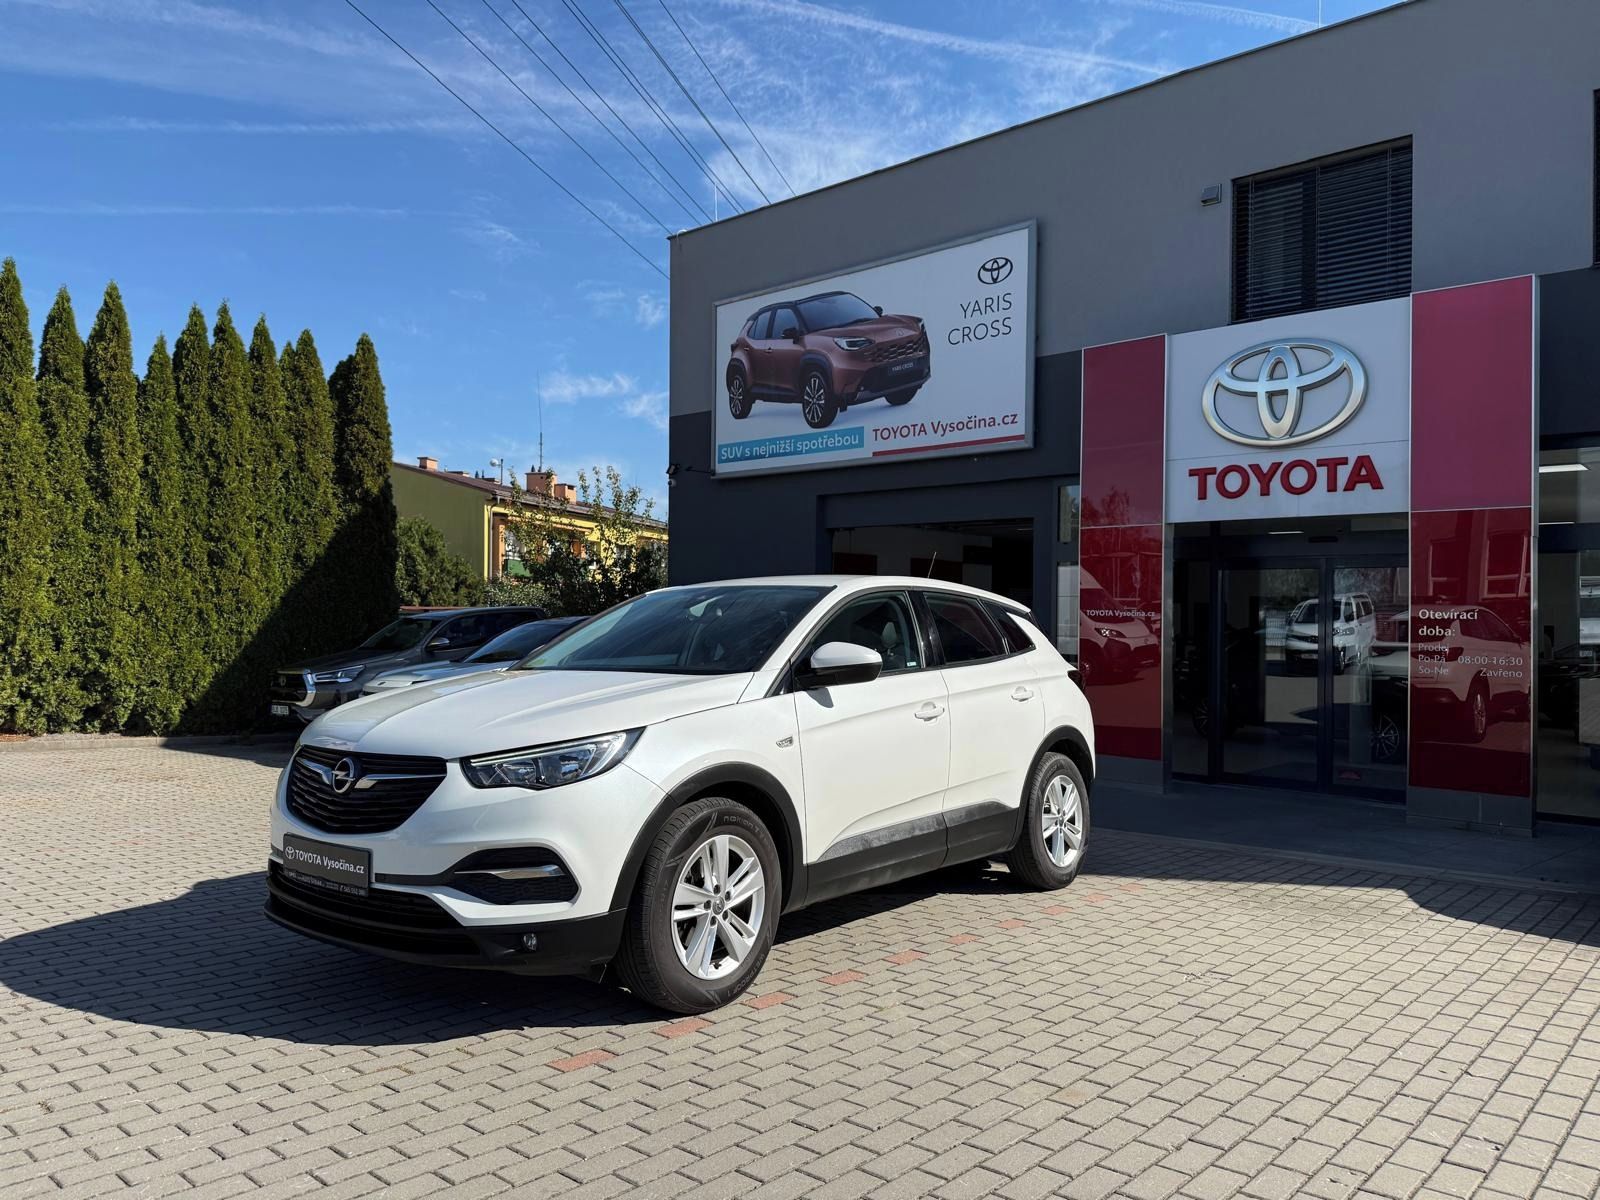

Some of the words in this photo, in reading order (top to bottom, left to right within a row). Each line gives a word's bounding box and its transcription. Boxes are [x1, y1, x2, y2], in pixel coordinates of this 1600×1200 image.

[960, 292, 1012, 319] YARIS
[948, 317, 1012, 346] CROSS
[872, 423, 927, 441] TOYOTA
[930, 412, 1018, 438] Vysočina.cz
[721, 446, 743, 460] SUV
[753, 440, 794, 458] nejnižší
[796, 433, 859, 454] spotřebou
[1188, 454, 1384, 501] TOYOTA
[1086, 609, 1113, 617] TOYOTA
[1114, 608, 1156, 618] Vysočina.cz
[1418, 608, 1479, 620] Otevírací
[1418, 625, 1456, 637] doba:
[1457, 655, 1523, 666] 08:00-16:30
[1480, 667, 1523, 678] Zavřeno
[295, 850, 322, 866] TOYOTA
[323, 856, 365, 874] Vysočina.cz
